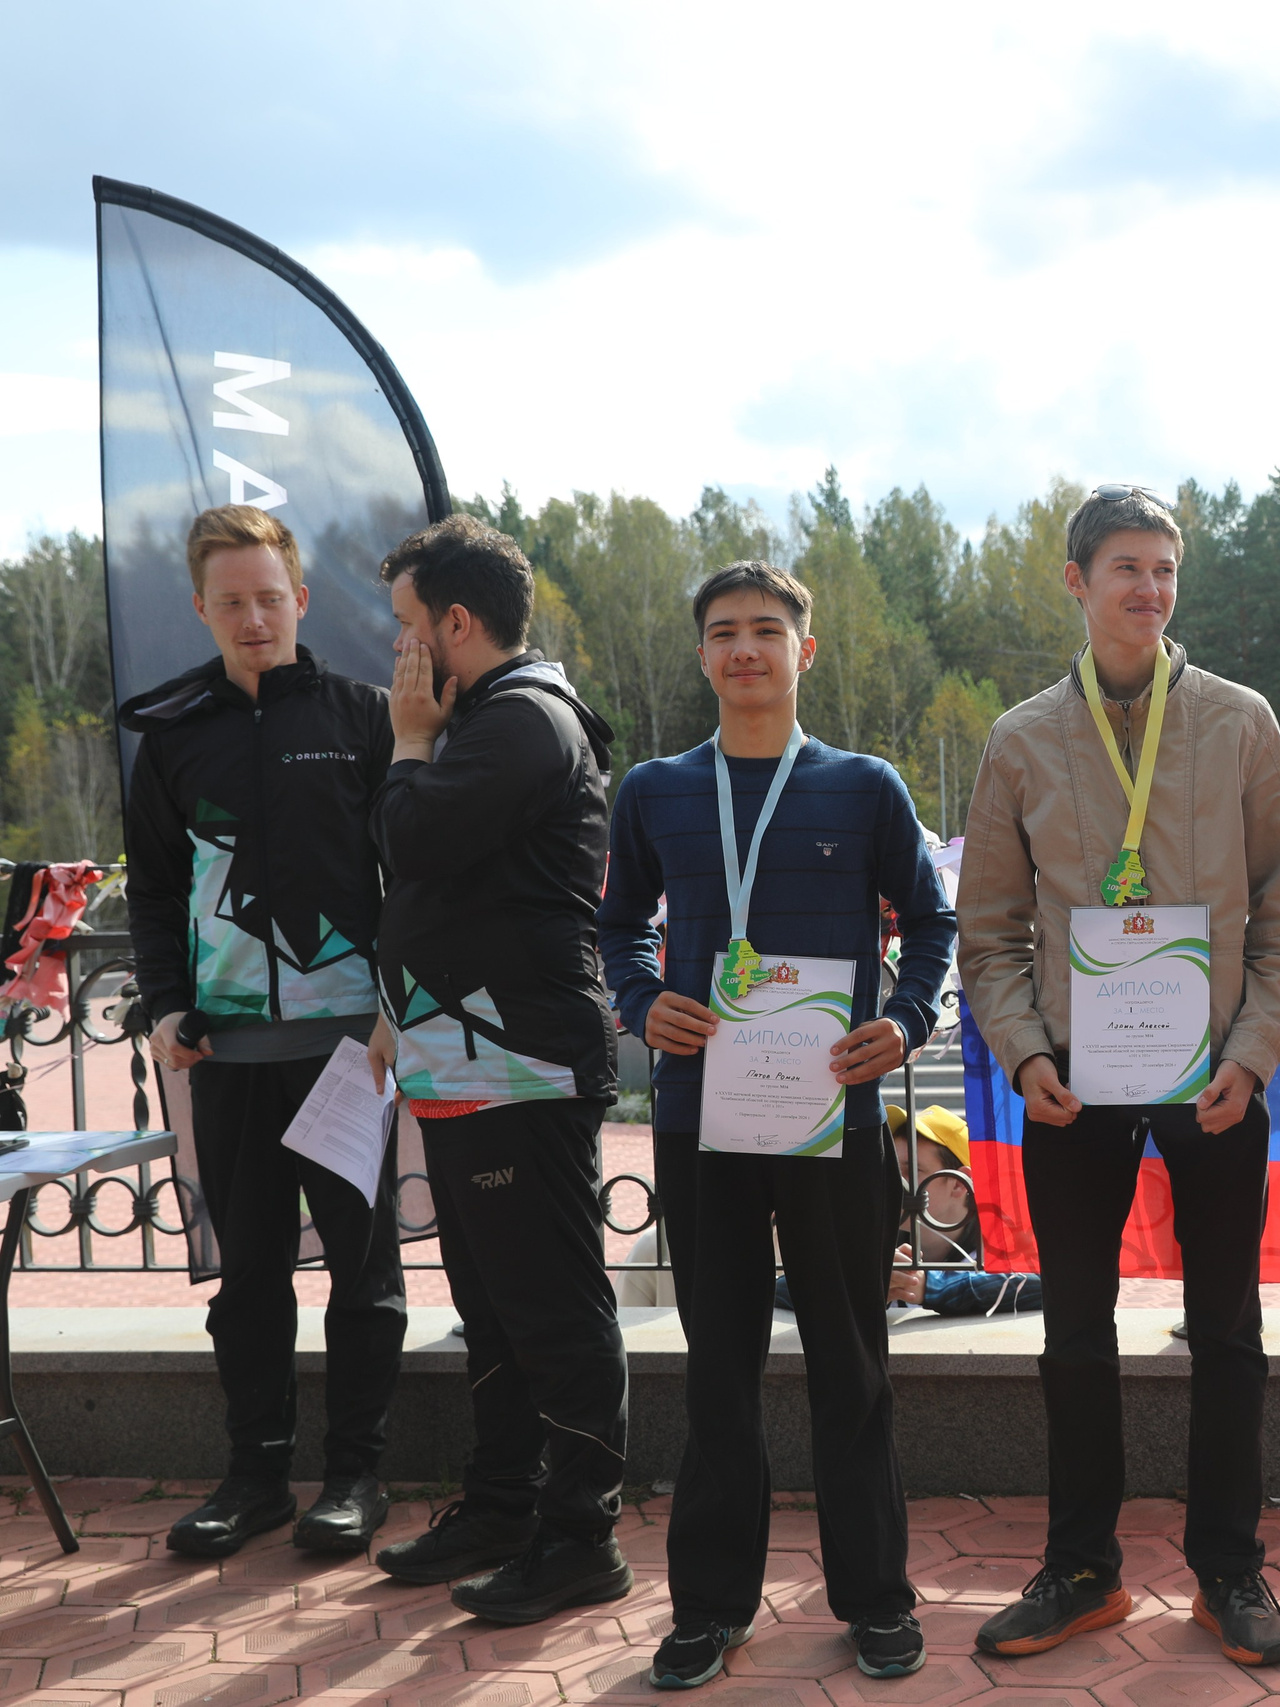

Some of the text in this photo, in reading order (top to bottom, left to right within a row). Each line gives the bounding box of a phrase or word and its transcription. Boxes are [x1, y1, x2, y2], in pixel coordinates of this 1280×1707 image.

[296, 752, 356, 762] ORIENTEAM
[1097, 981, 1181, 998] ДИПЛОМ
[733, 1029, 820, 1048] ДИПЛОМ
[775, 1072, 801, 1081] Роман
[471, 1166, 514, 1190] RAY
